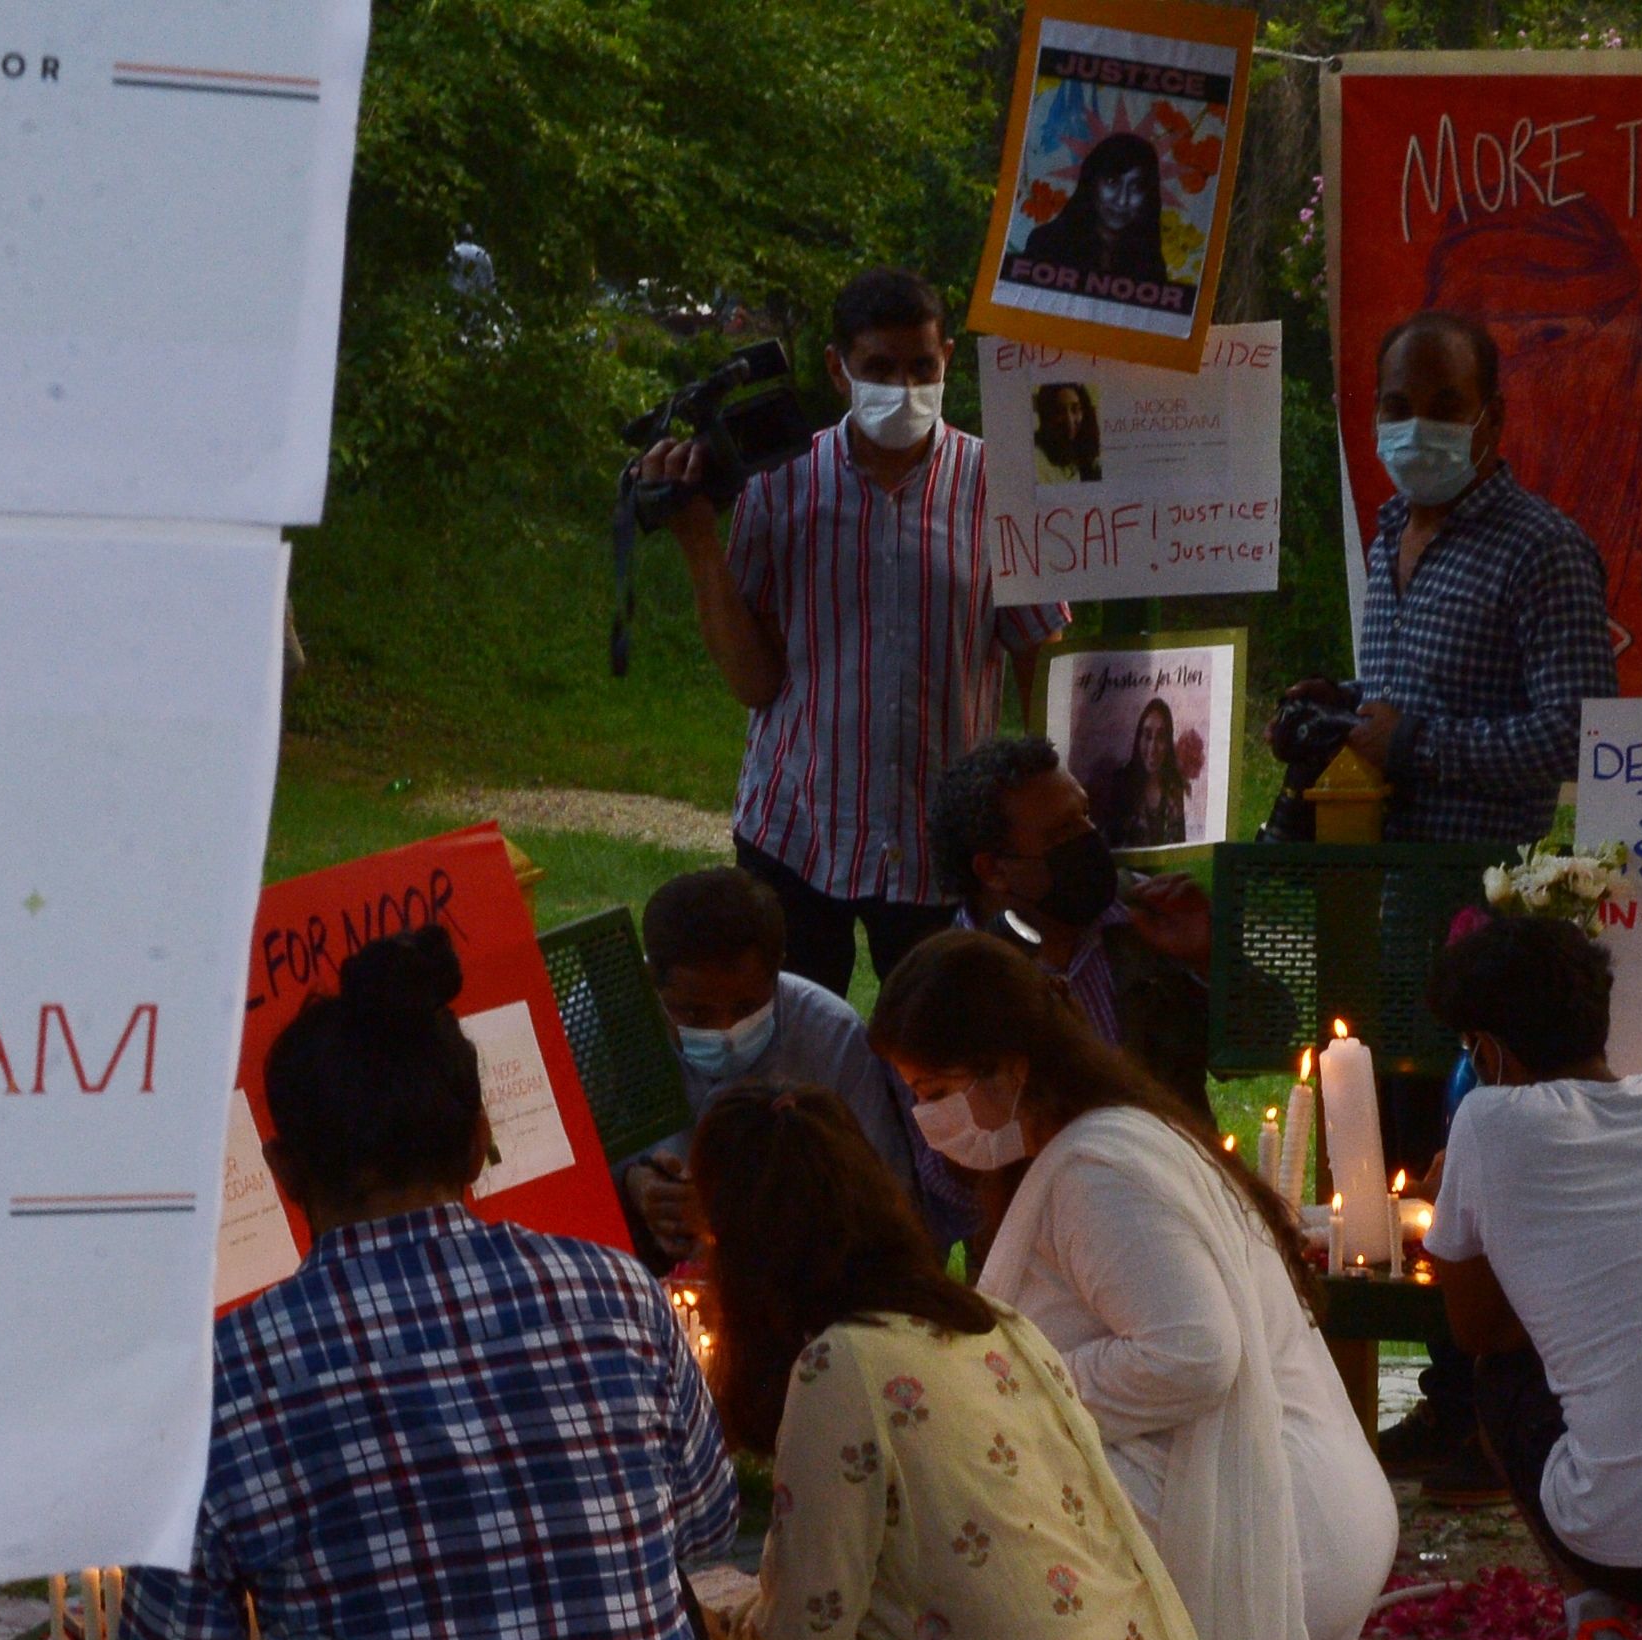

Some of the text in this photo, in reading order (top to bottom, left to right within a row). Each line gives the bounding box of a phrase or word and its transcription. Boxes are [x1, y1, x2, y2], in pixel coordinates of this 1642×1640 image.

[1056, 53, 1207, 98] JUSTICE
[1401, 113, 1596, 242] MORE
[1010, 257, 1184, 309] FOR NOOR
[262, 914, 340, 998] FOR
